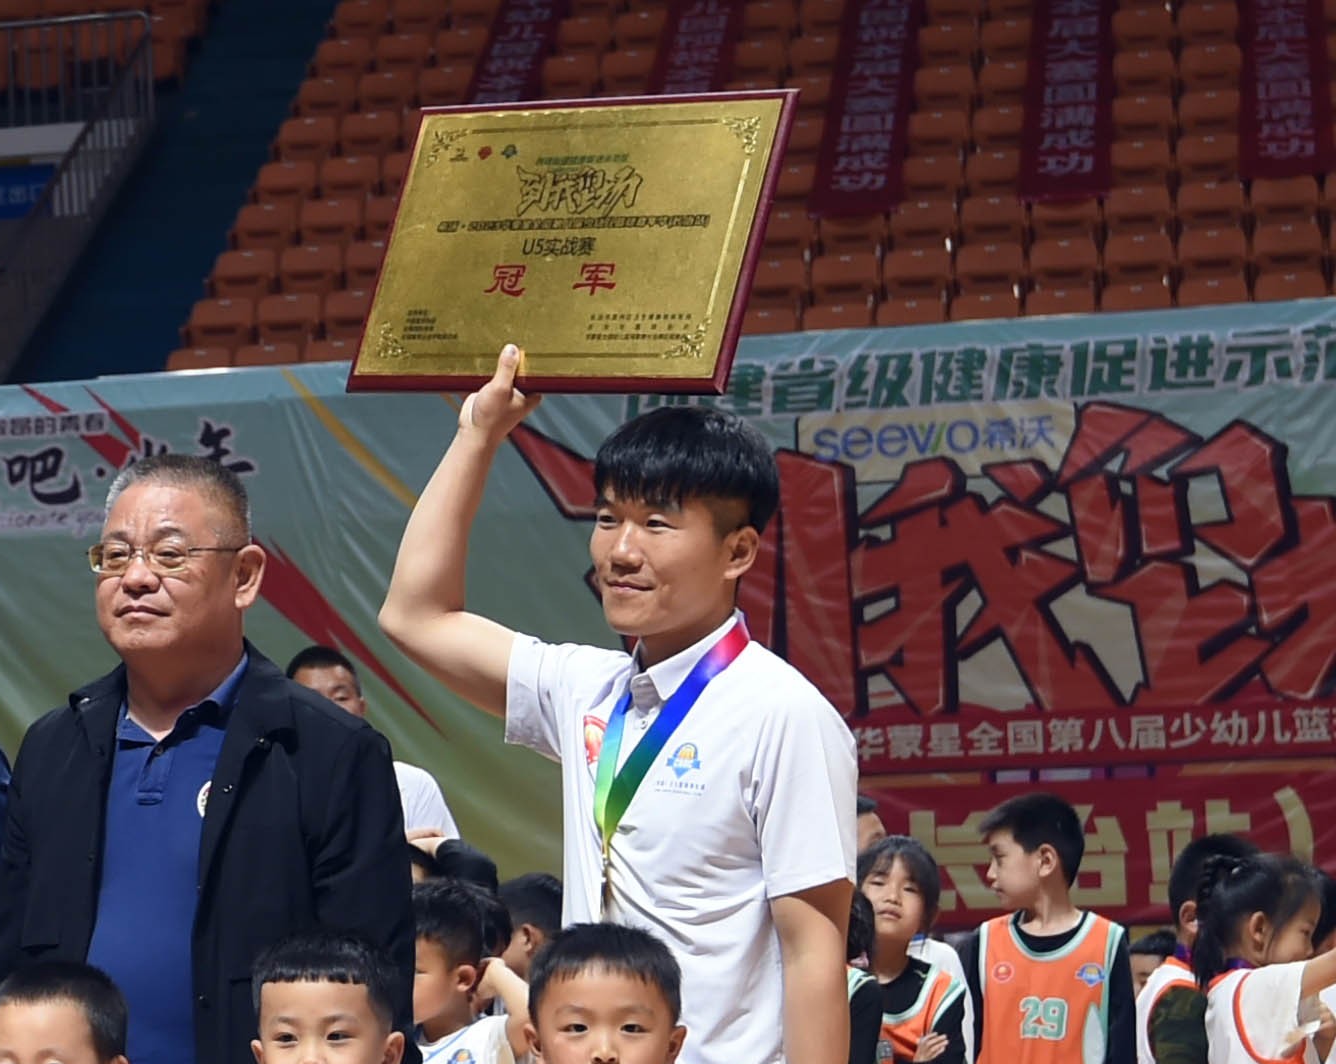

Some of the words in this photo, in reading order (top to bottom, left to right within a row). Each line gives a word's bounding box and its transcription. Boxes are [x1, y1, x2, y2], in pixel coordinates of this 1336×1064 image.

[521, 237, 597, 256] U5实战赛
[484, 262, 617, 297] 冠军
[856, 706, 1336, 763] 华蒙星全国第八届少幼儿篮
[1020, 996, 1068, 1040] 29
